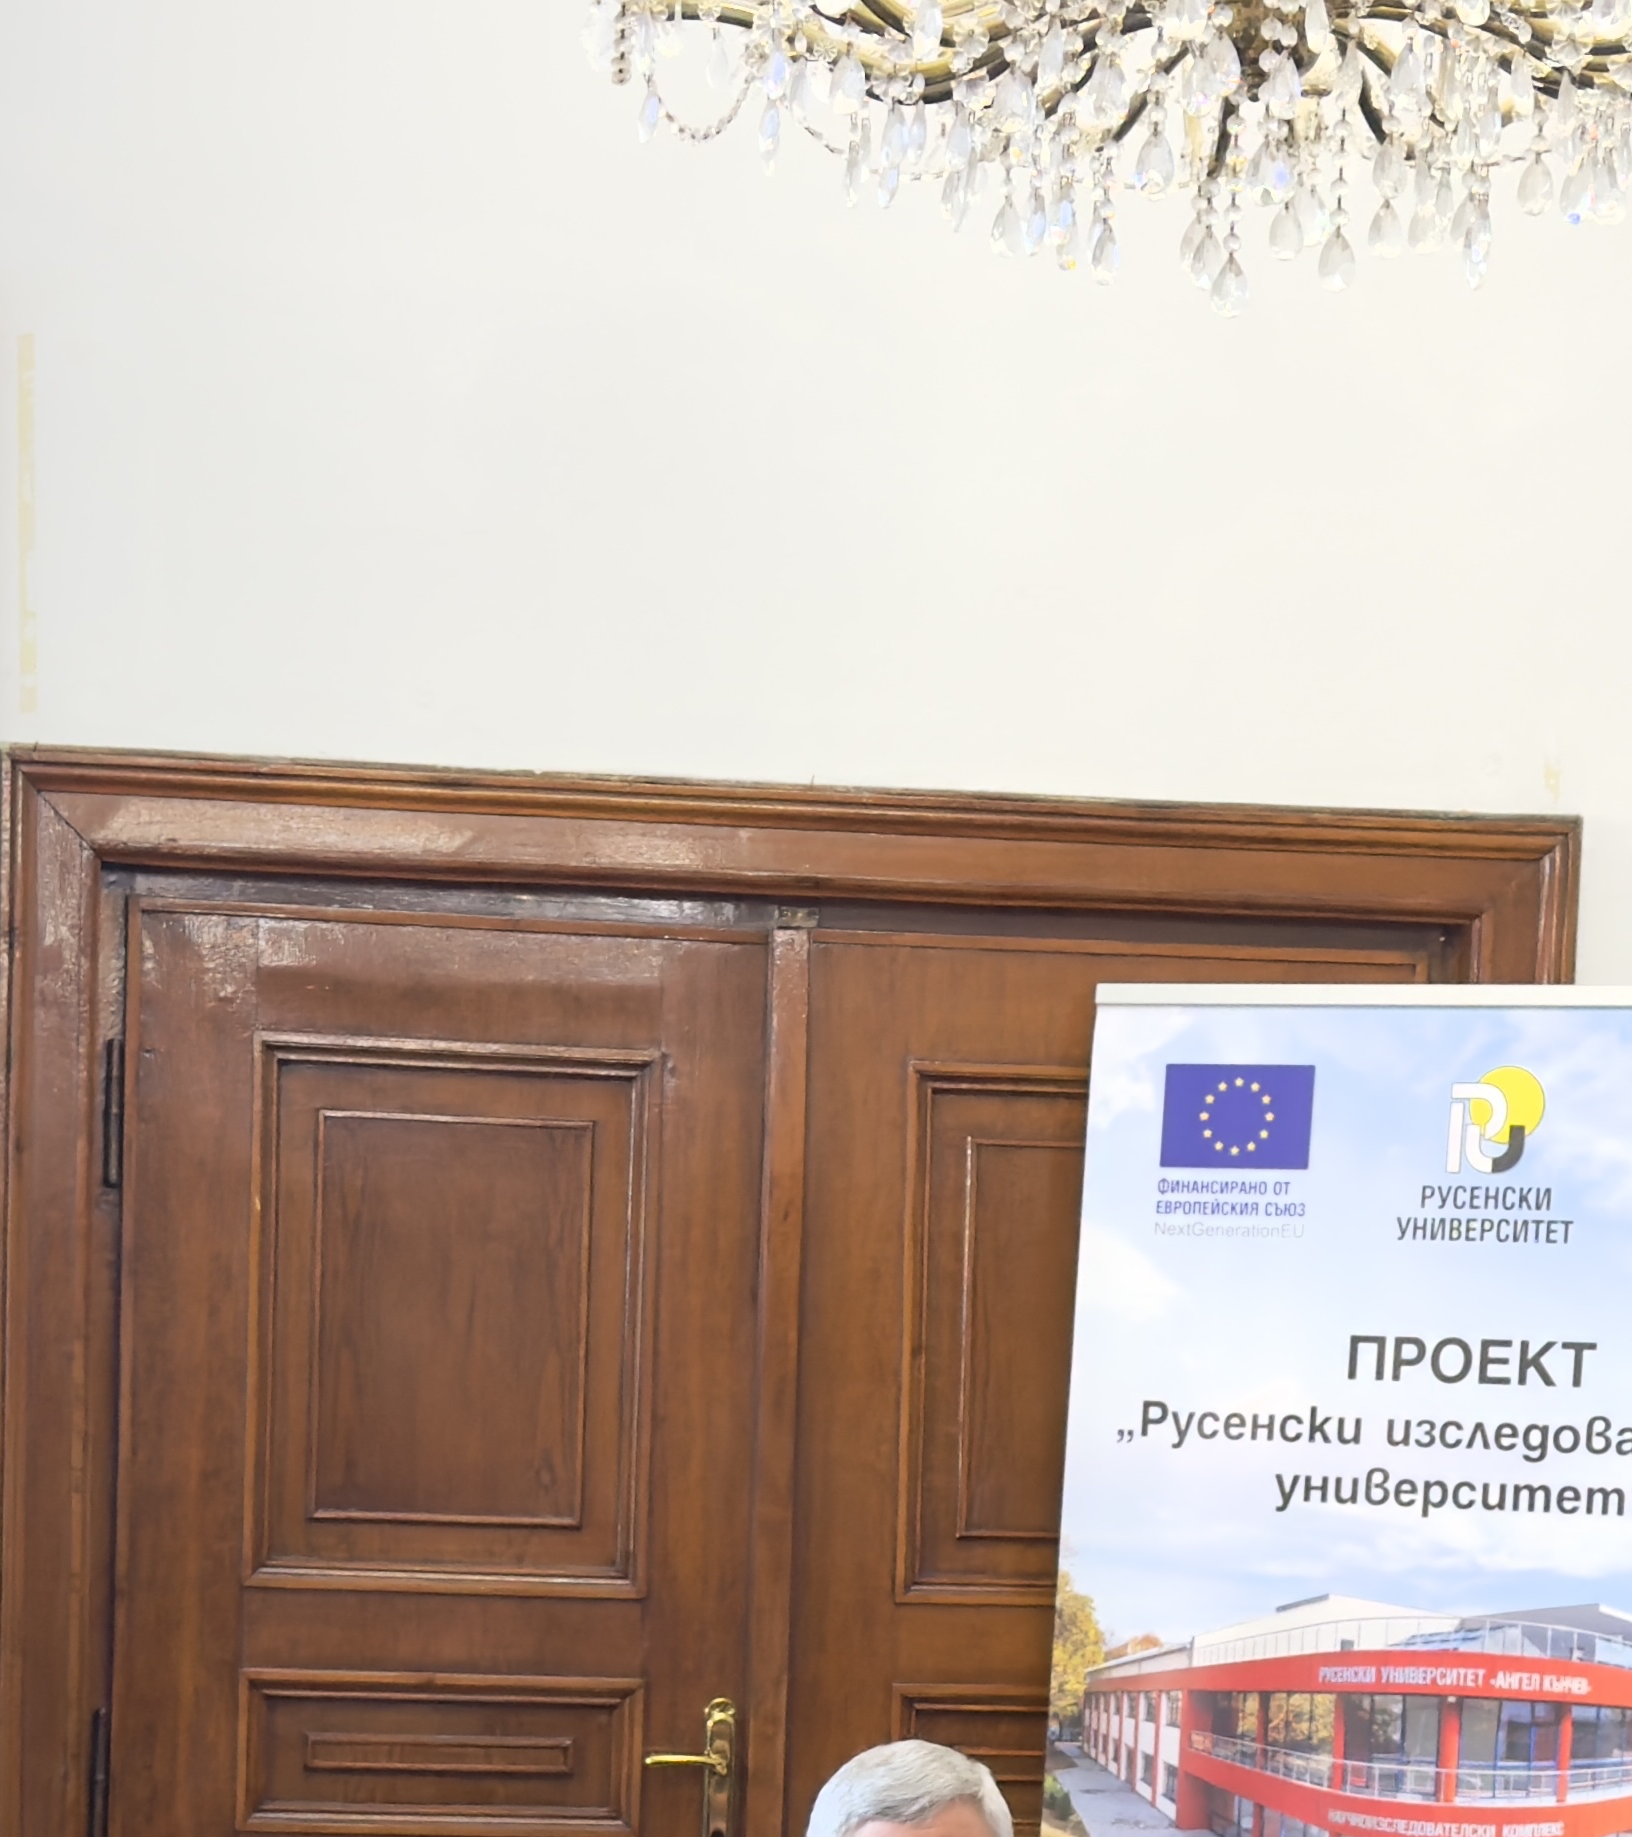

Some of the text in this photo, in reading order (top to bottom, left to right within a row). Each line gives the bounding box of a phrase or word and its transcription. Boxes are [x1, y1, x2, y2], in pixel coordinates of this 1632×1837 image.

[1158, 1178, 1290, 1196] ФИНАНСИРАНО ОТ
[1156, 1199, 1305, 1217] ЕВРОПЕЙСКИЯ СЪЮЗ
[1421, 1185, 1551, 1211] РУСЕНСКИ
[1155, 1221, 1304, 1238] NextGenerationEU
[1397, 1217, 1574, 1244] УНИВЕРСИТЕТ
[1348, 1335, 1597, 1387] ПРОЕКТ
[1319, 1666, 1376, 1683] РУСЕНСКИ
[1381, 1667, 1486, 1687] УНИВЕРСИТЕТ
